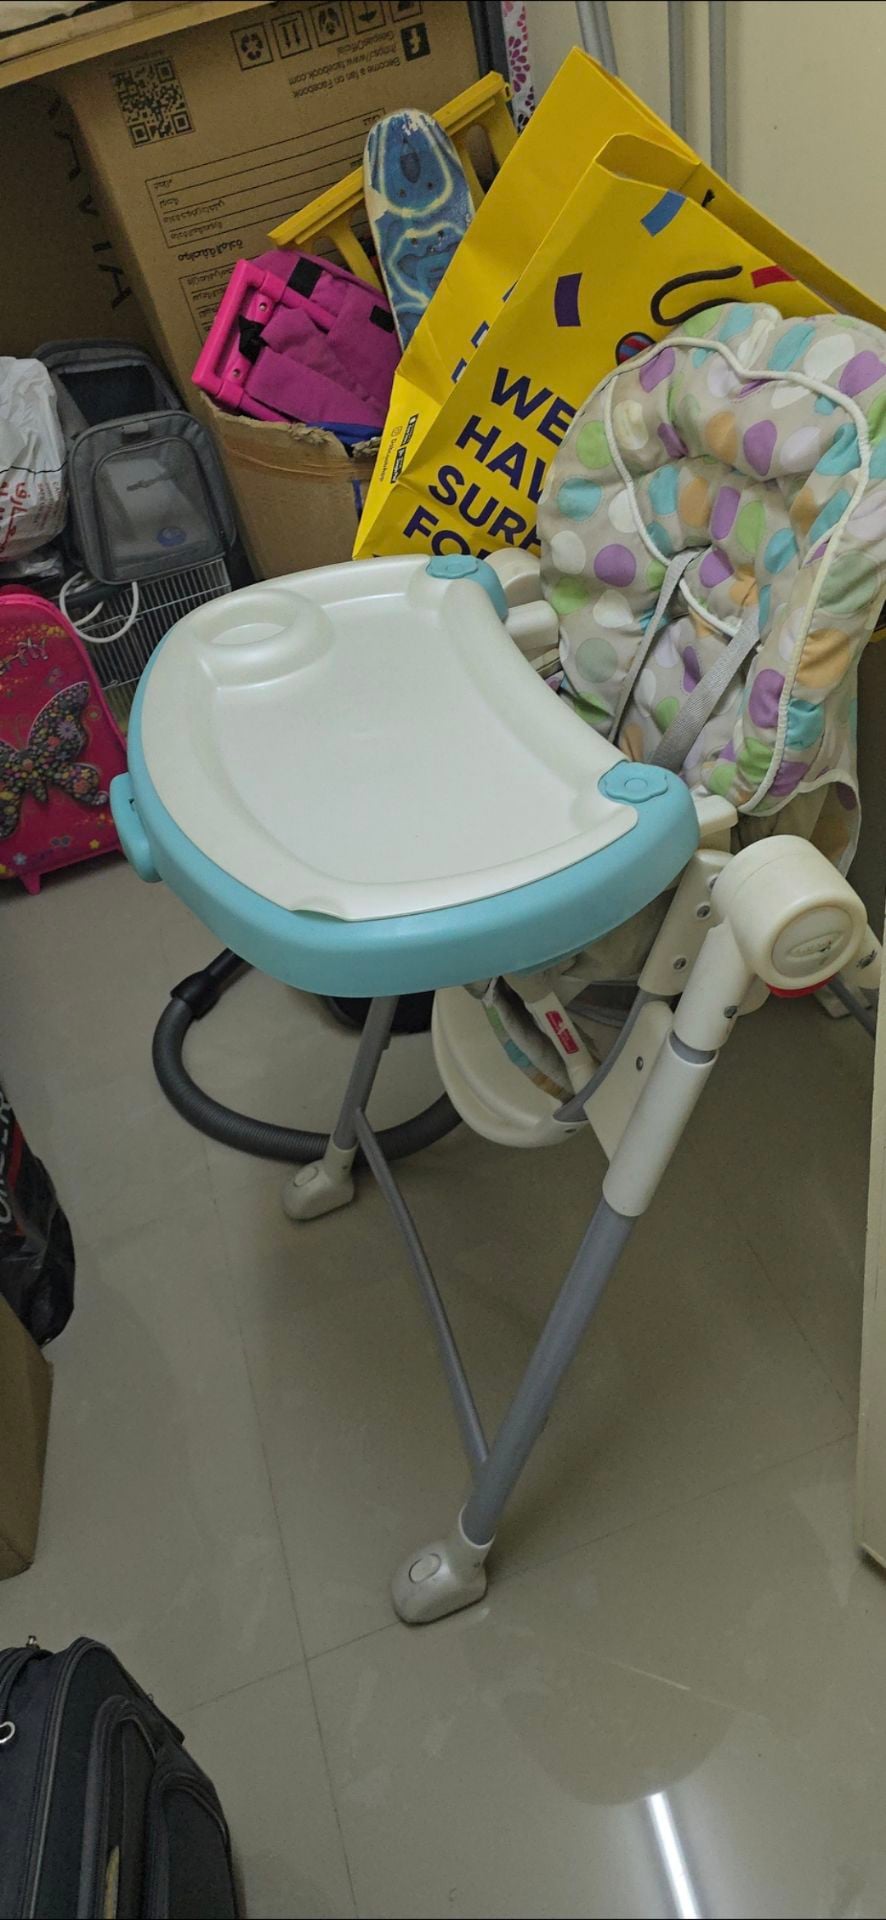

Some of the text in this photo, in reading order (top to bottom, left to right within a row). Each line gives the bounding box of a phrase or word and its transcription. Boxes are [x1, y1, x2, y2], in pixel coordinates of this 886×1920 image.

[367, 56, 401, 74] Become
[334, 74, 346, 84] on
[345, 70, 360, 81] fan
[292, 79, 334, 99] Facebook
[490, 367, 578, 447] WE
[455, 415, 547, 505] HAV
[403, 505, 493, 560] FO
